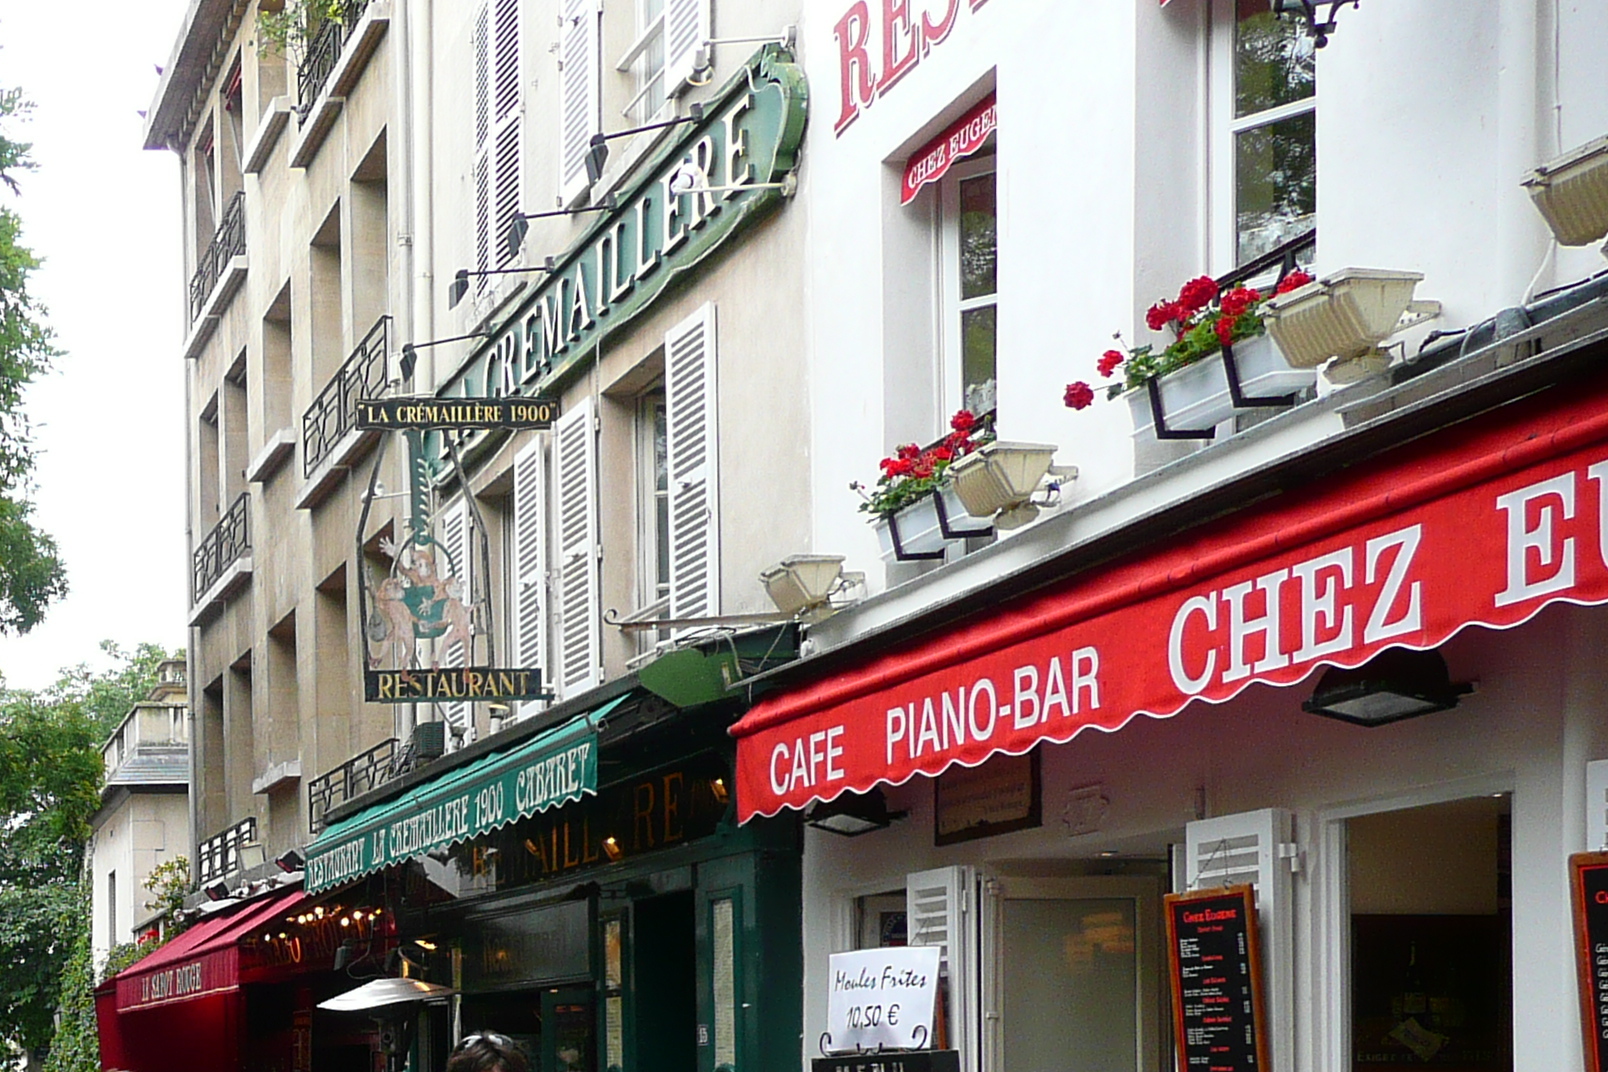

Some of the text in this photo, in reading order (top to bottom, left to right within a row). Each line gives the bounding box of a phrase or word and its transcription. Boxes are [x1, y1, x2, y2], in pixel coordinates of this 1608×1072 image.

[833, 0, 992, 139] RES
[907, 143, 946, 189] CHEZ
[396, 402, 503, 423] CRÉMAILLÈRE
[1168, 523, 1423, 696] CHEZ
[378, 671, 529, 699] RESTAURANT
[770, 645, 1100, 796] CAFE PIANO-BAR
[475, 781, 504, 829] 1900
[516, 742, 590, 812] CABARET
[835, 967, 876, 992] Moules
[846, 1003, 900, 1030] 10,50 €
